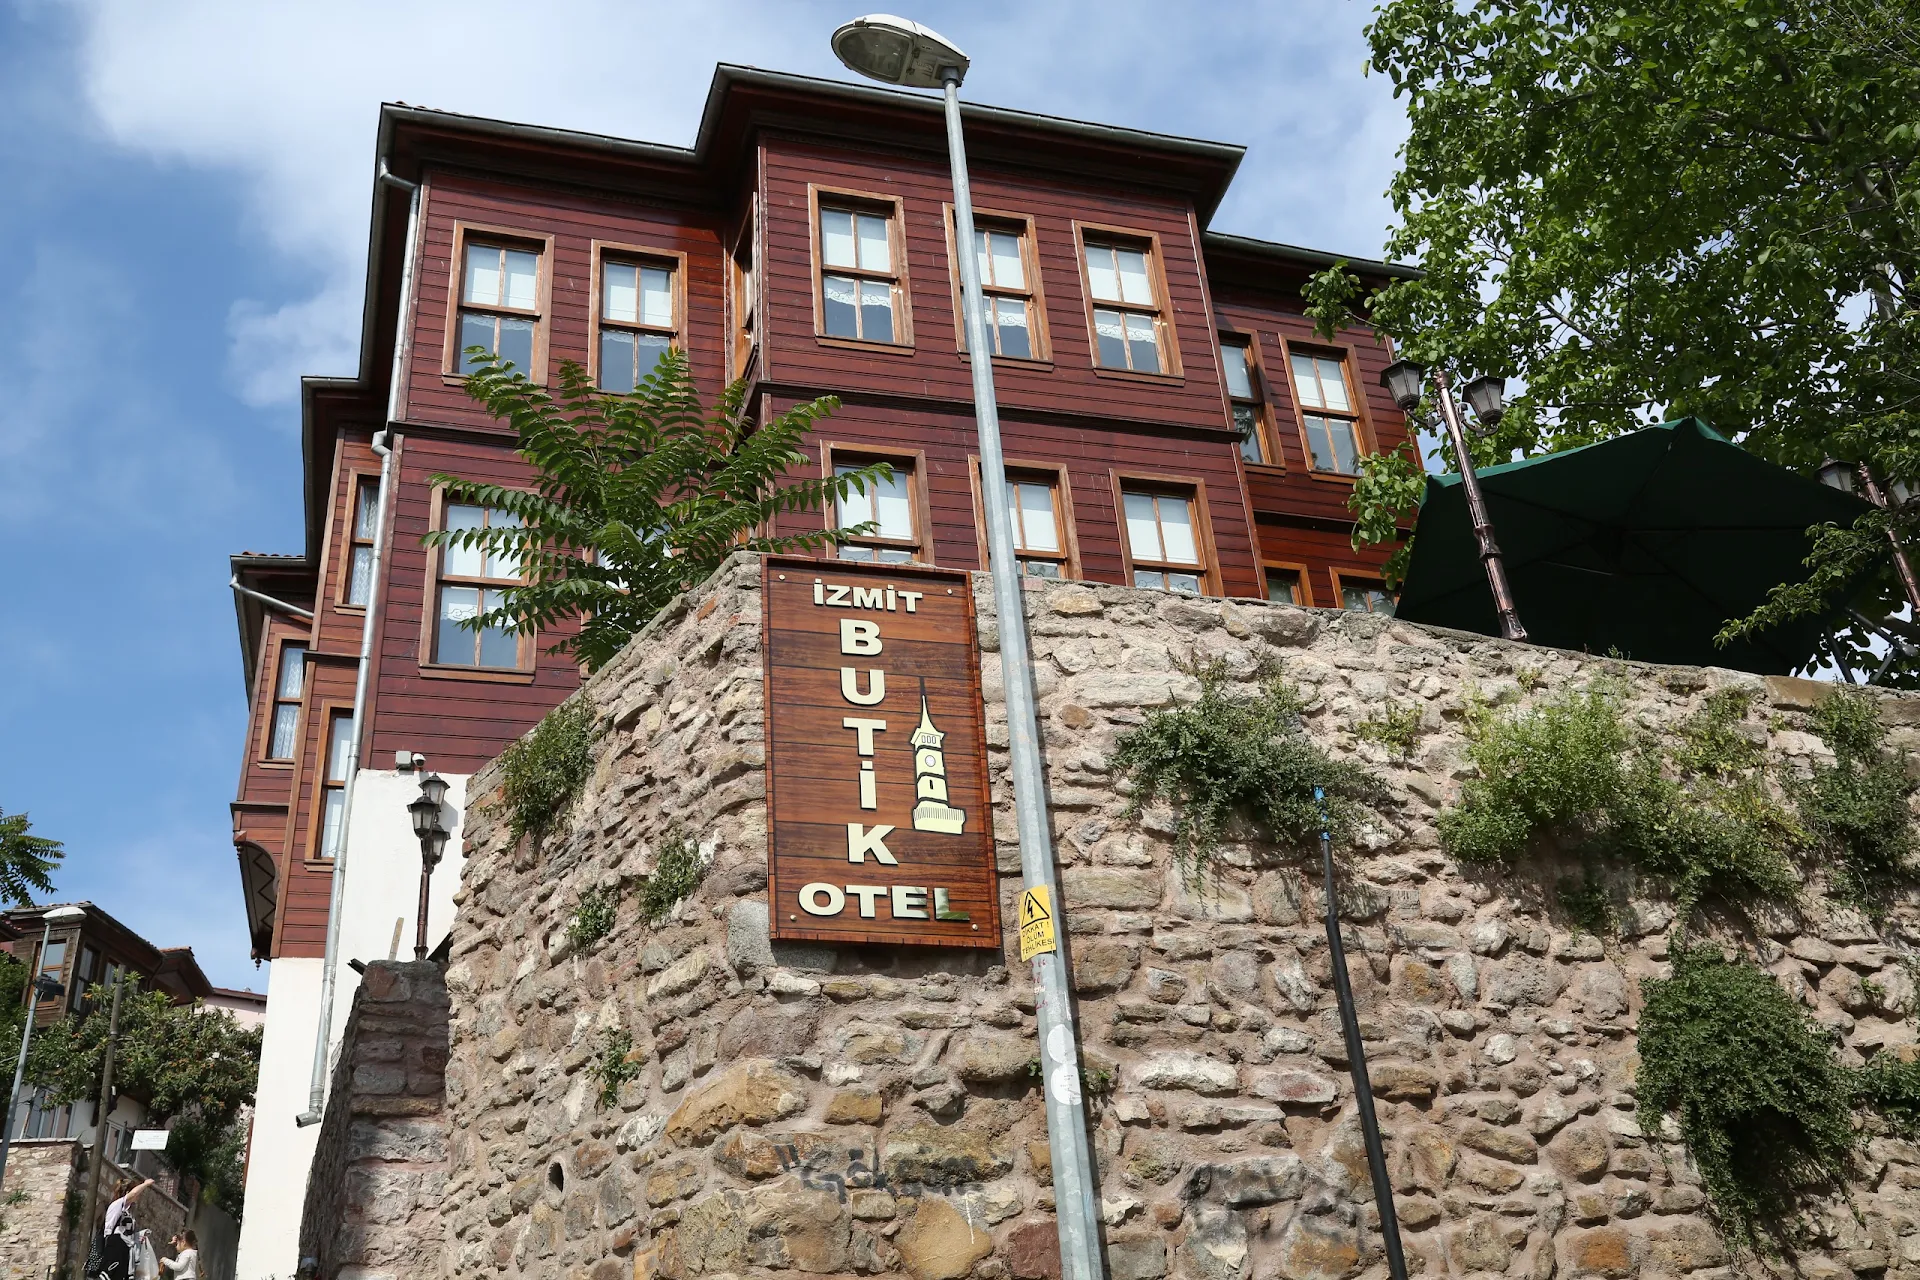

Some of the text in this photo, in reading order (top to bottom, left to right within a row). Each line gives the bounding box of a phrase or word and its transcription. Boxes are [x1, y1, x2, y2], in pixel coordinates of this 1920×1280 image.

[813, 578, 923, 613] İZMİT
[840, 618, 899, 866] BUTİK
[798, 882, 970, 921] OTEL
